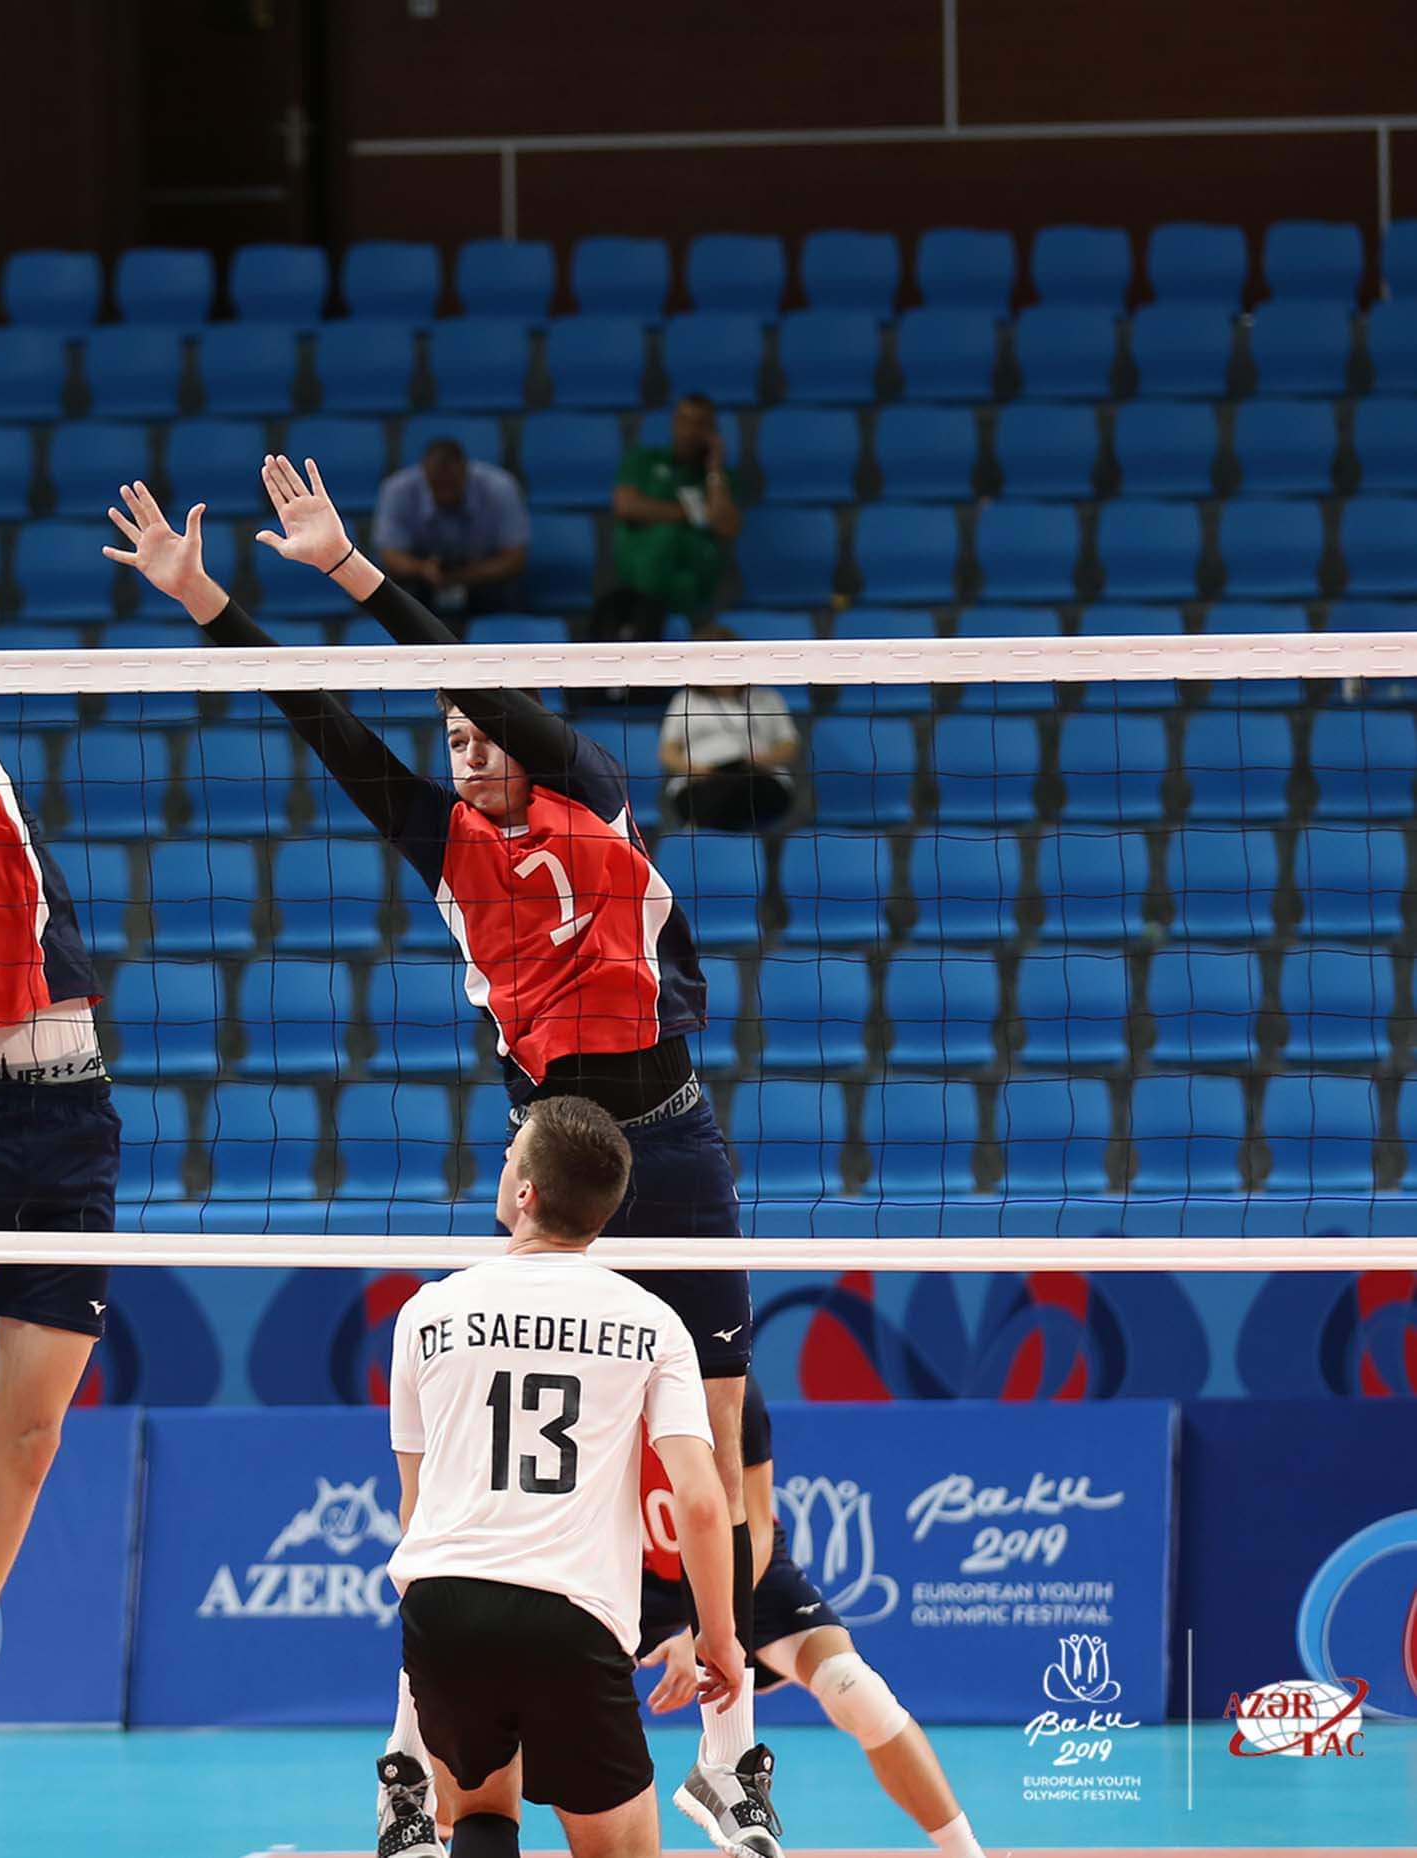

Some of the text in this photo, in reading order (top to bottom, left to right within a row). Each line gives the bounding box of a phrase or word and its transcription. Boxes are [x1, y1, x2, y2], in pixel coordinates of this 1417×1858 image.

[419, 1312, 657, 1362] DE SAEDELEER
[486, 1371, 581, 1495] 13
[906, 1472, 1125, 1542] Baku
[960, 1524, 1068, 1574] 2019
[195, 1564, 400, 1628] AZERÇ
[911, 1603, 1112, 1626] OLYMPIC FESTIVAL
[912, 1581, 1114, 1602] EUROPEAN YOUTH
